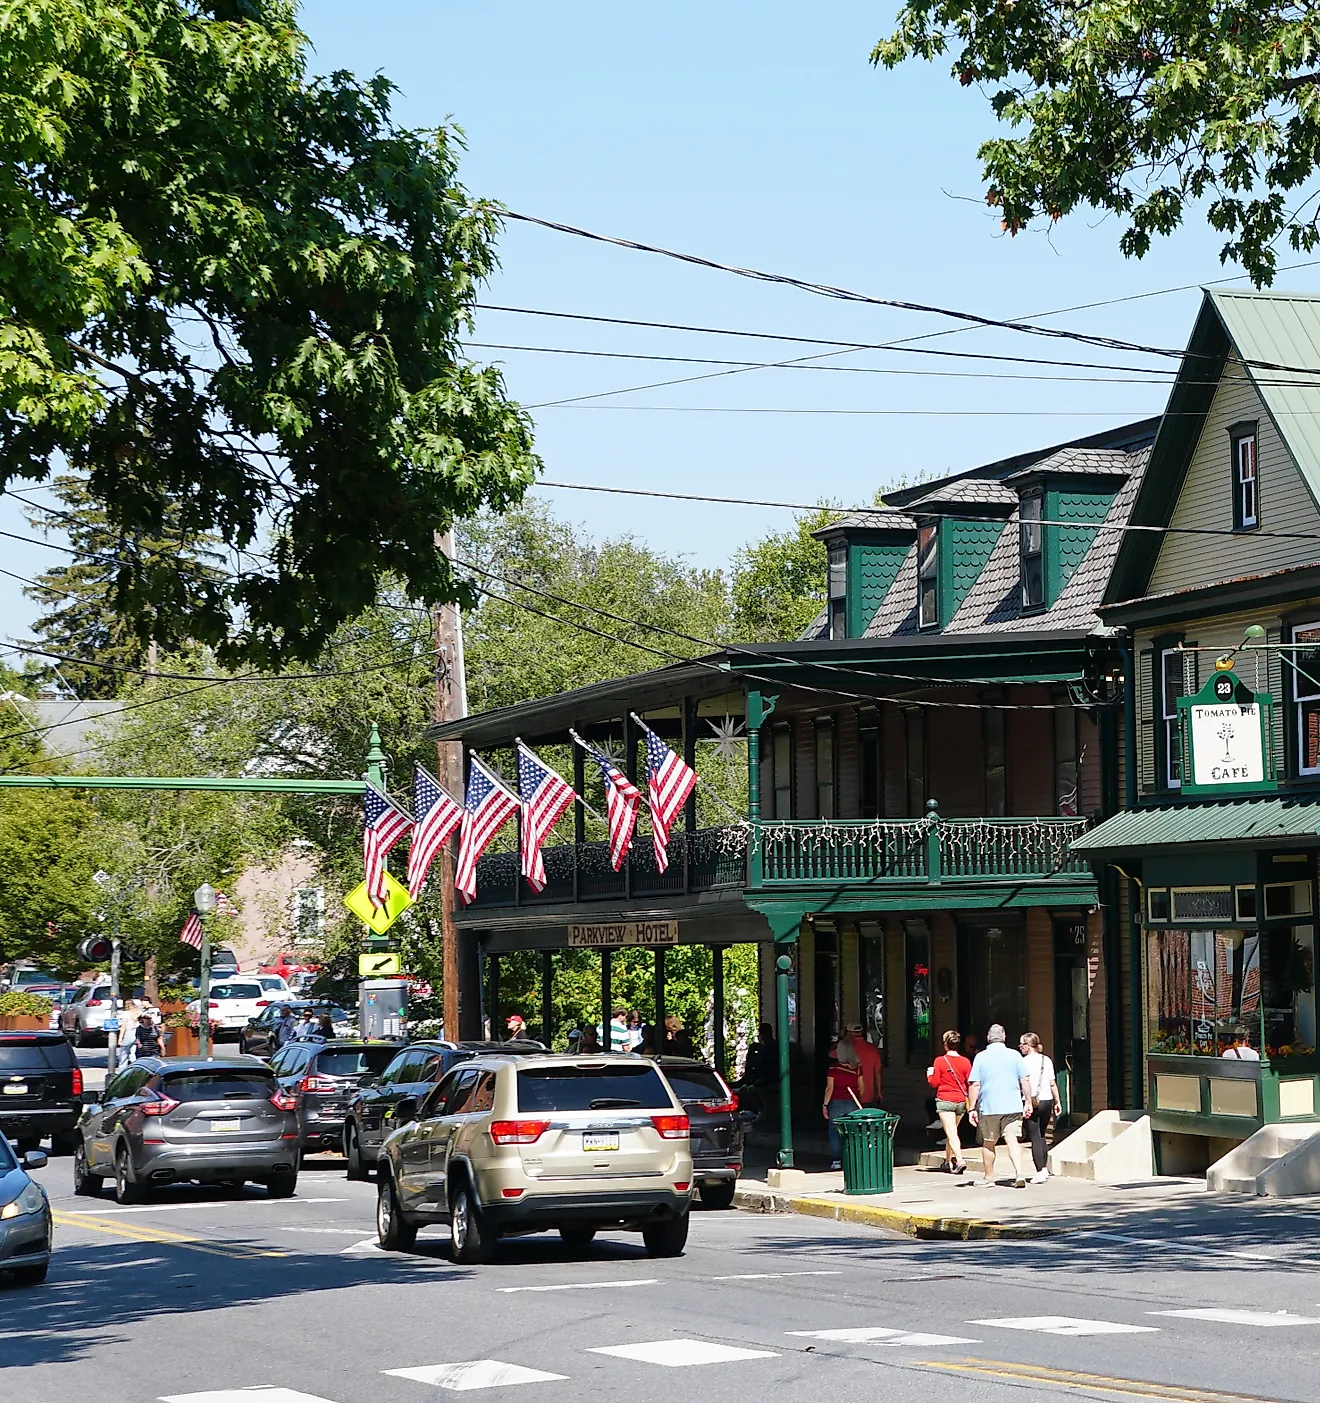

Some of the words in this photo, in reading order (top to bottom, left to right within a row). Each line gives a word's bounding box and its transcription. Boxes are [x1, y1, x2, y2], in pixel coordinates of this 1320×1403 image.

[1217, 683, 1231, 694] 23
[1196, 708, 1237, 719] TOMATO
[1240, 706, 1256, 717] PIE
[1211, 764, 1249, 780] CAFÉ
[572, 924, 627, 944] PARKVIEW
[635, 922, 674, 943] HOTEL
[1074, 925, 1085, 945] 25
